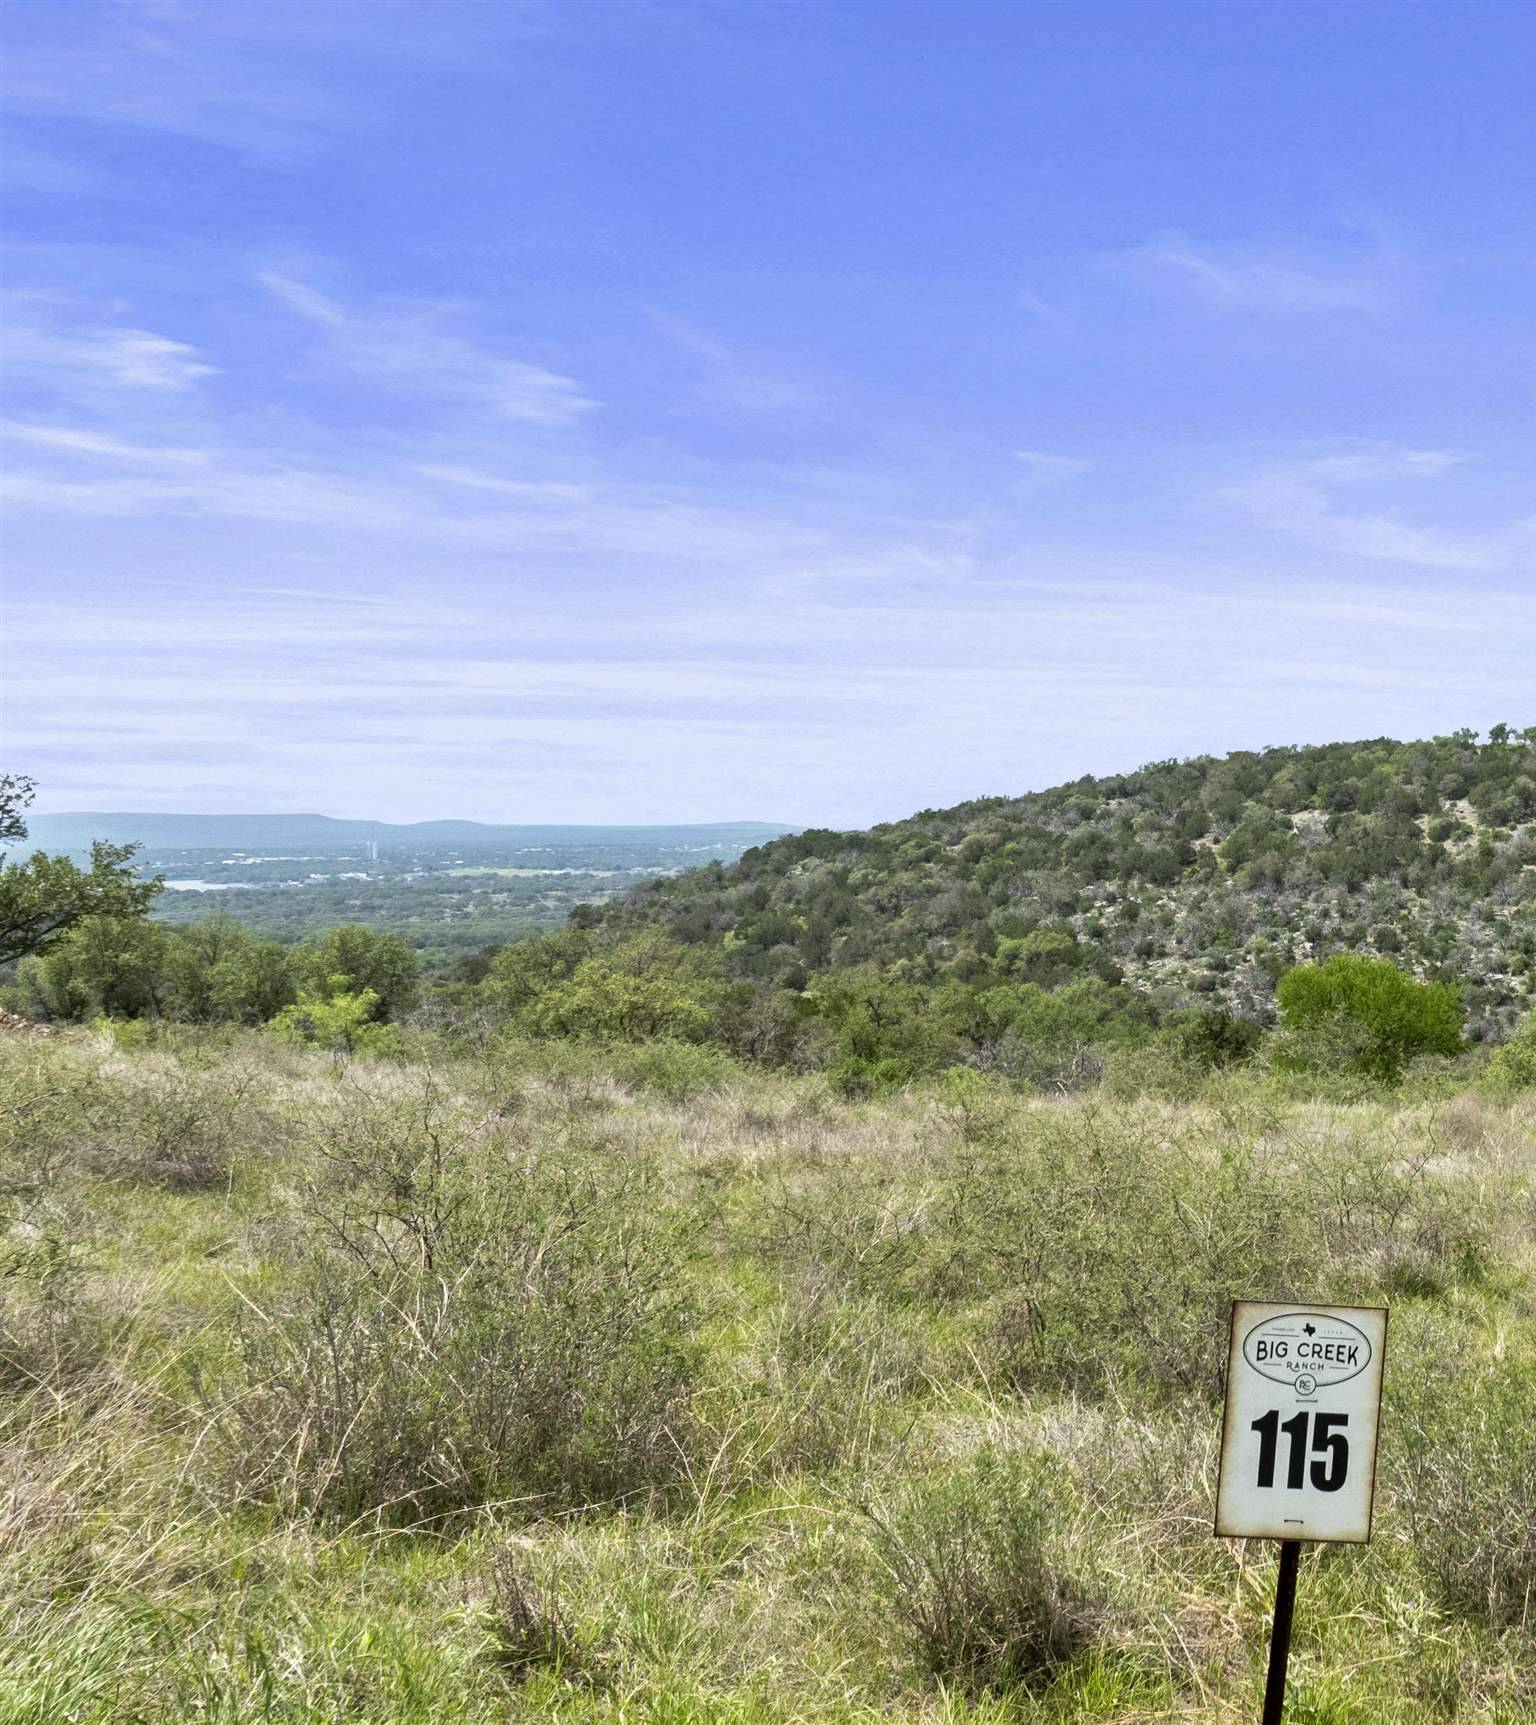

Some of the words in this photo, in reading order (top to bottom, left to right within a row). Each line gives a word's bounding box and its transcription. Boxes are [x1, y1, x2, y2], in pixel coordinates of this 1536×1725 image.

[1256, 1340, 1288, 1361] BIG
[1297, 1342, 1359, 1367] CREEK
[1286, 1361, 1325, 1373] RANCH
[1250, 1409, 1349, 1493] 115
